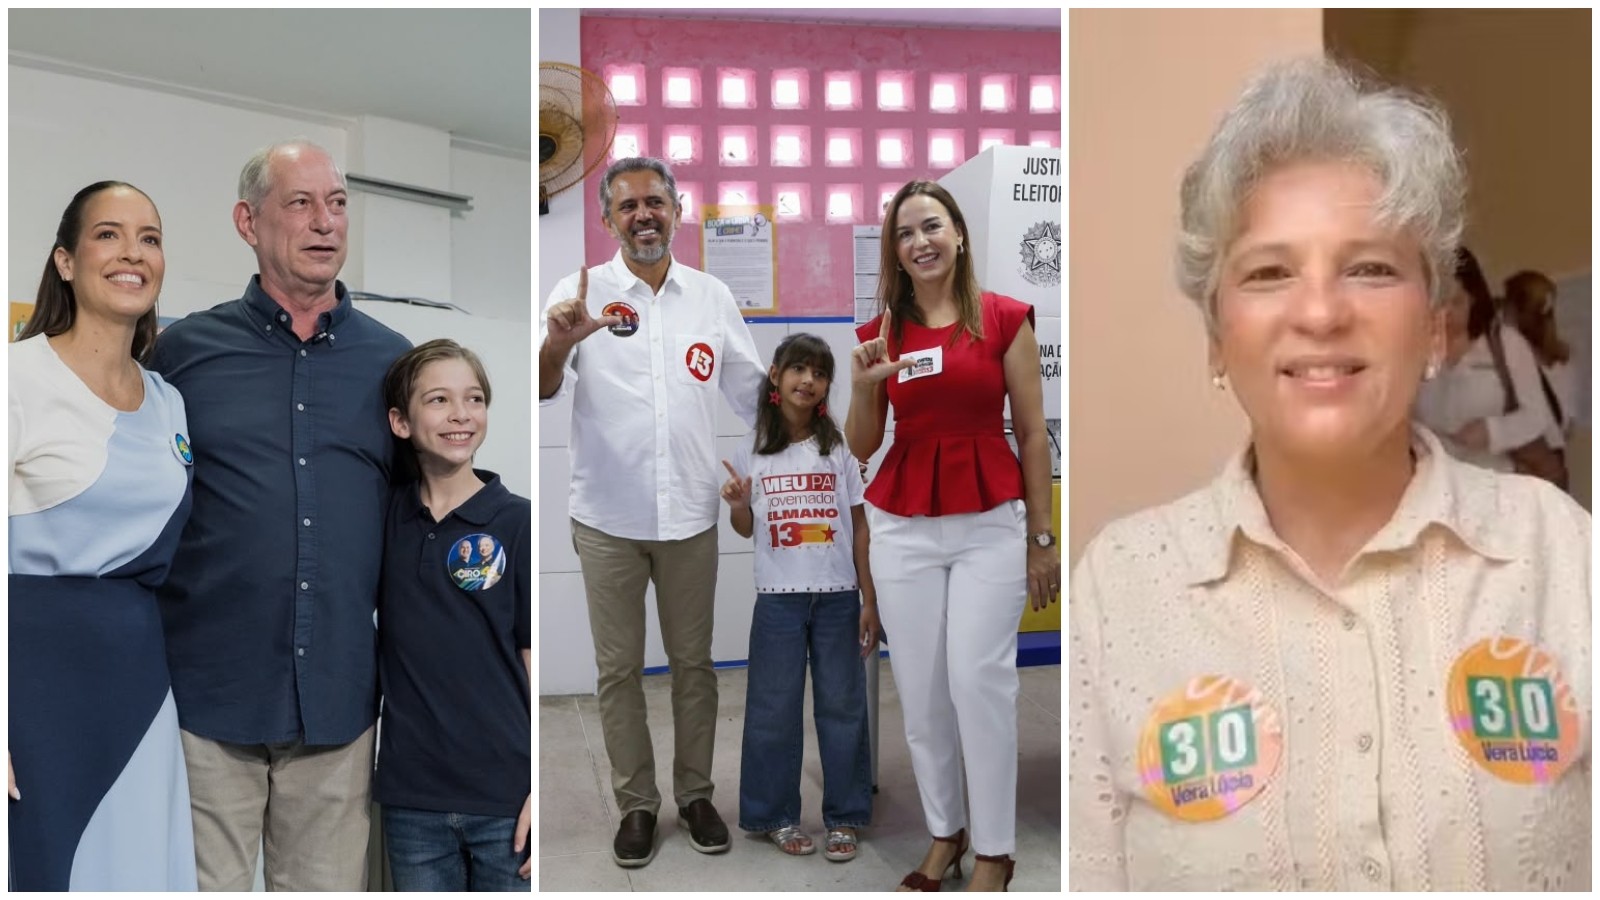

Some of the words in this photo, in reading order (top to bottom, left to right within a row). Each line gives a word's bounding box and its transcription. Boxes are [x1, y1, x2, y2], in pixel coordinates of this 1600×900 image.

[1022, 156, 1061, 176] JUSTI
[689, 346, 713, 377] 13
[764, 476, 808, 493] MEU
[811, 474, 835, 490] PAI
[768, 509, 838, 521] ELMANO
[769, 522, 803, 548] 13
[1475, 679, 1549, 733] 30
[1168, 712, 1247, 775] 30
[1481, 741, 1518, 762] Vera
[1171, 784, 1208, 806] Vera
